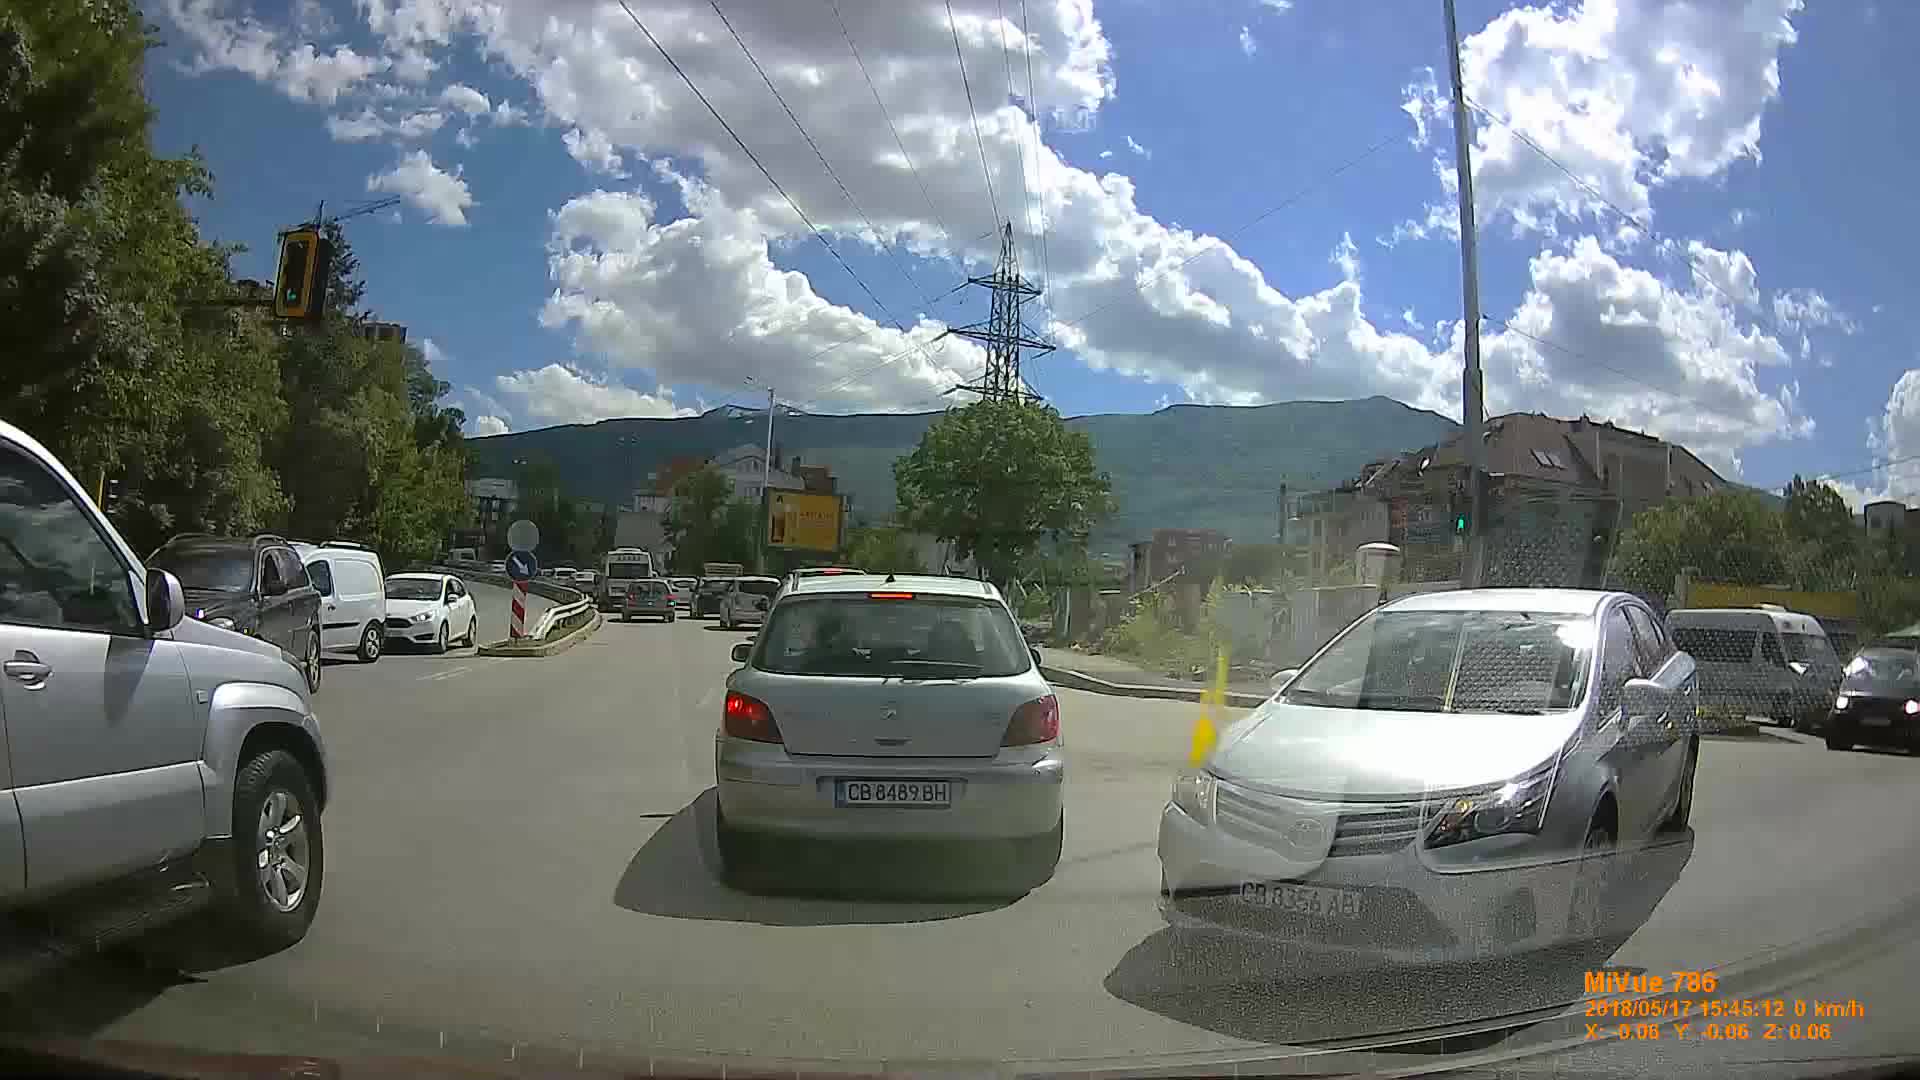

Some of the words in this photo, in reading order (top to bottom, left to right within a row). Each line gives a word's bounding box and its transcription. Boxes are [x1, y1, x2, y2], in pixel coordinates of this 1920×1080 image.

[848, 783, 872, 801] CB
[875, 783, 919, 801] 8489
[922, 783, 946, 801] BH
